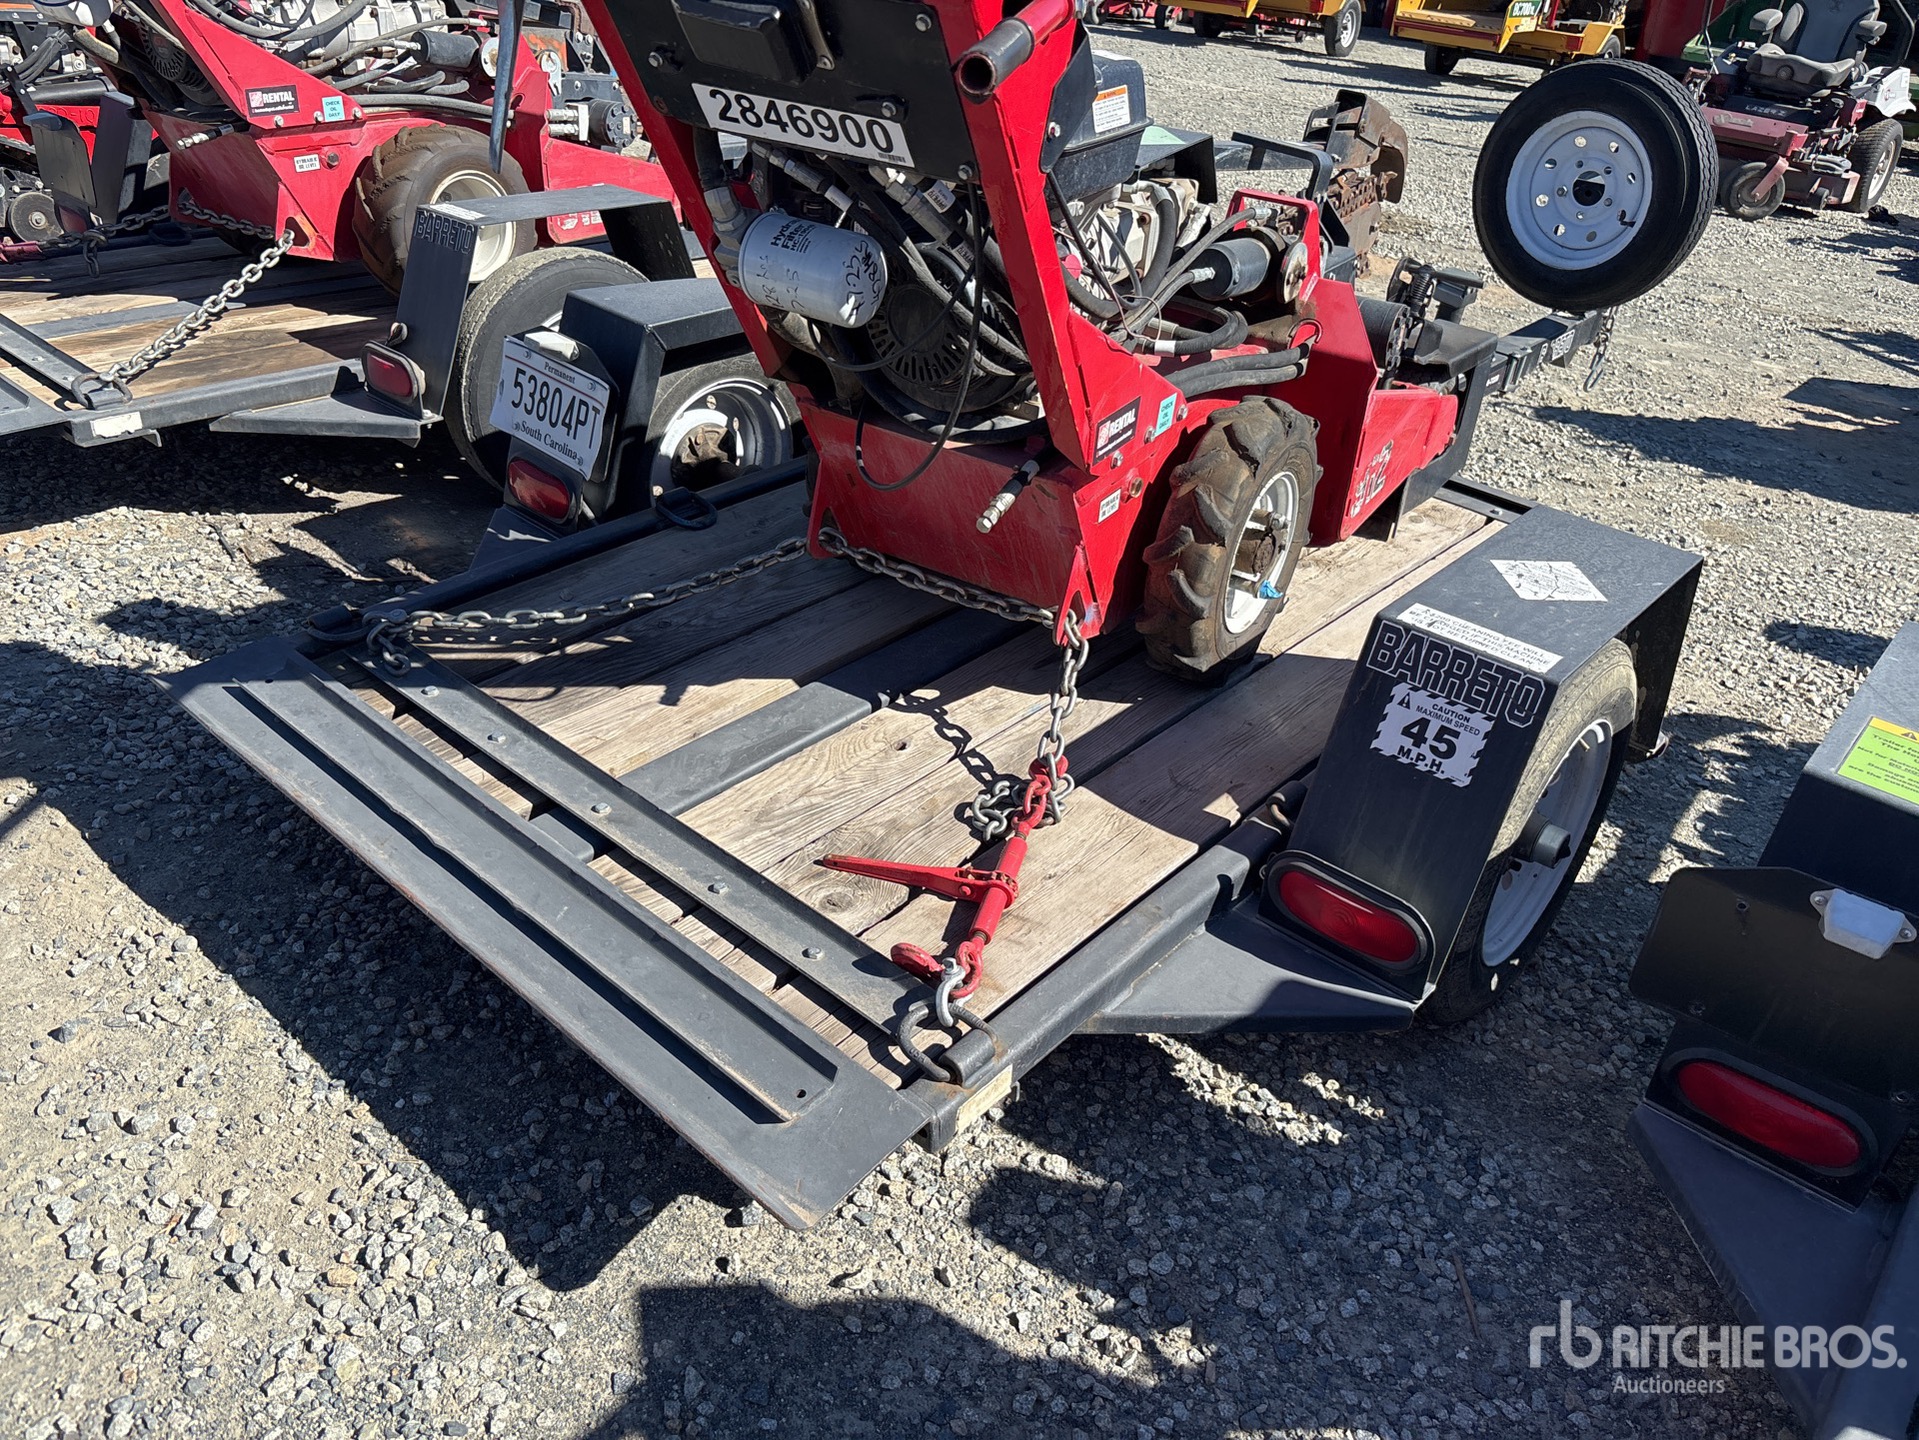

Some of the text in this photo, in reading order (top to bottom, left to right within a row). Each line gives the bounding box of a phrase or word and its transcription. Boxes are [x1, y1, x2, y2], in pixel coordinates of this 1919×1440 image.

[263, 91, 295, 103] RENTAL
[709, 89, 894, 153] 2846900
[414, 209, 475, 254] BARRETO
[544, 361, 576, 384] Permanent
[511, 367, 601, 450] 53804PT
[1109, 408, 1136, 437] RENTAL
[520, 420, 579, 461] South Carolina
[1446, 629, 1500, 652] RETURNED
[1500, 649, 1534, 666] CLEAN
[1452, 619, 1501, 641] CLEANING
[1523, 646, 1545, 658] WILL
[1505, 643, 1551, 665] MACHINE
[1366, 619, 1546, 729] BARRETO
[1415, 705, 1481, 737] MAXIMUM SPEED
[1432, 702, 1471, 723] CAUTION
[1400, 716, 1461, 760] 45
[1397, 745, 1445, 775] M.P.H.
